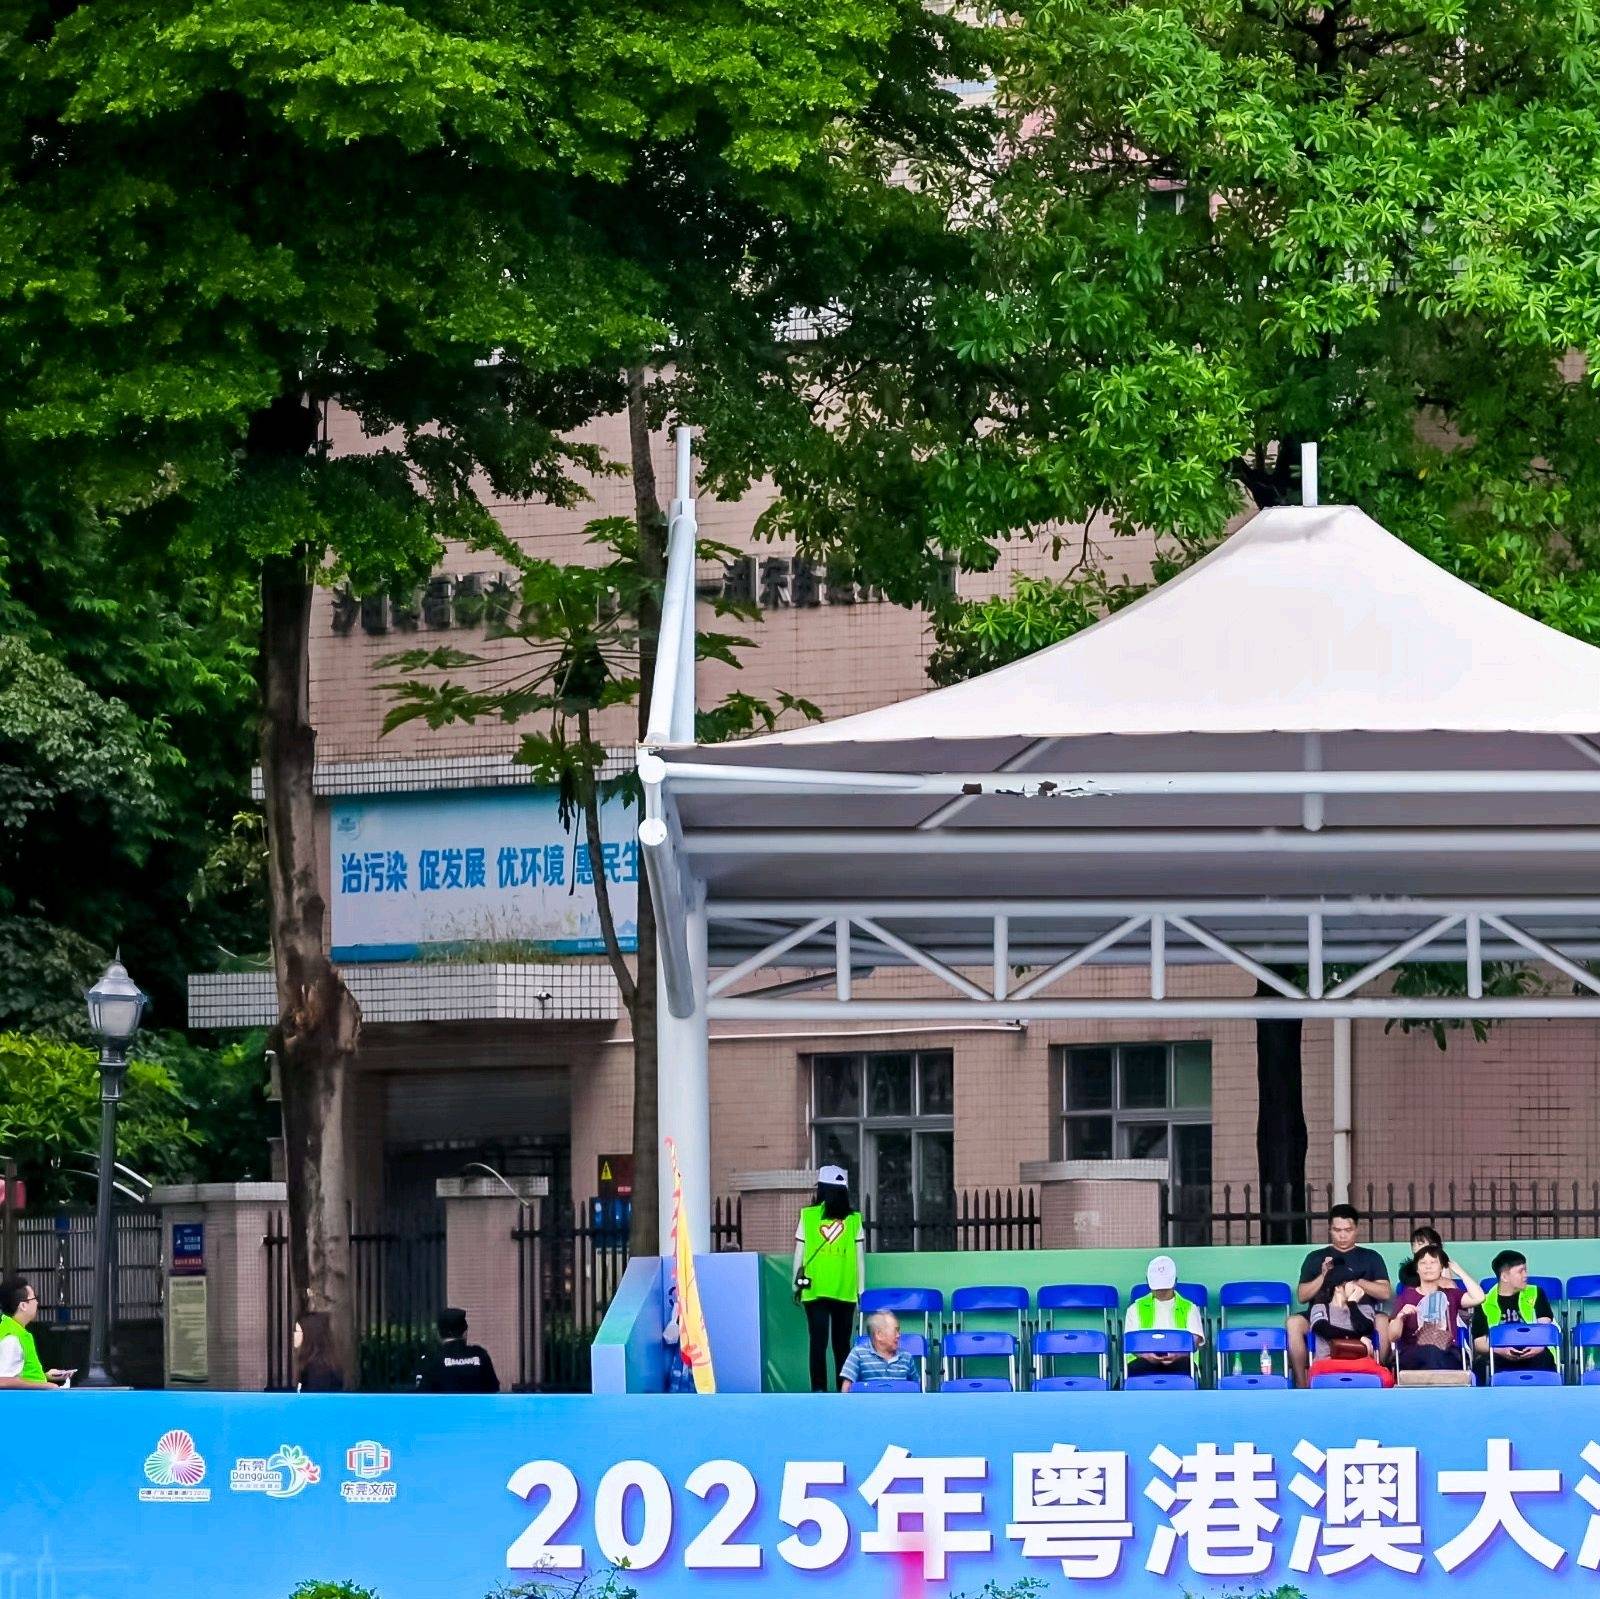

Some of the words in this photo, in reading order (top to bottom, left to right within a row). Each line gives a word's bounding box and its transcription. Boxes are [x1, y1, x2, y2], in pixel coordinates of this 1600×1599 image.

[341, 851, 408, 893] 治污染
[419, 847, 486, 890] 促发展
[496, 845, 565, 888] 优环境
[343, 1484, 394, 1496] 东莞文旅
